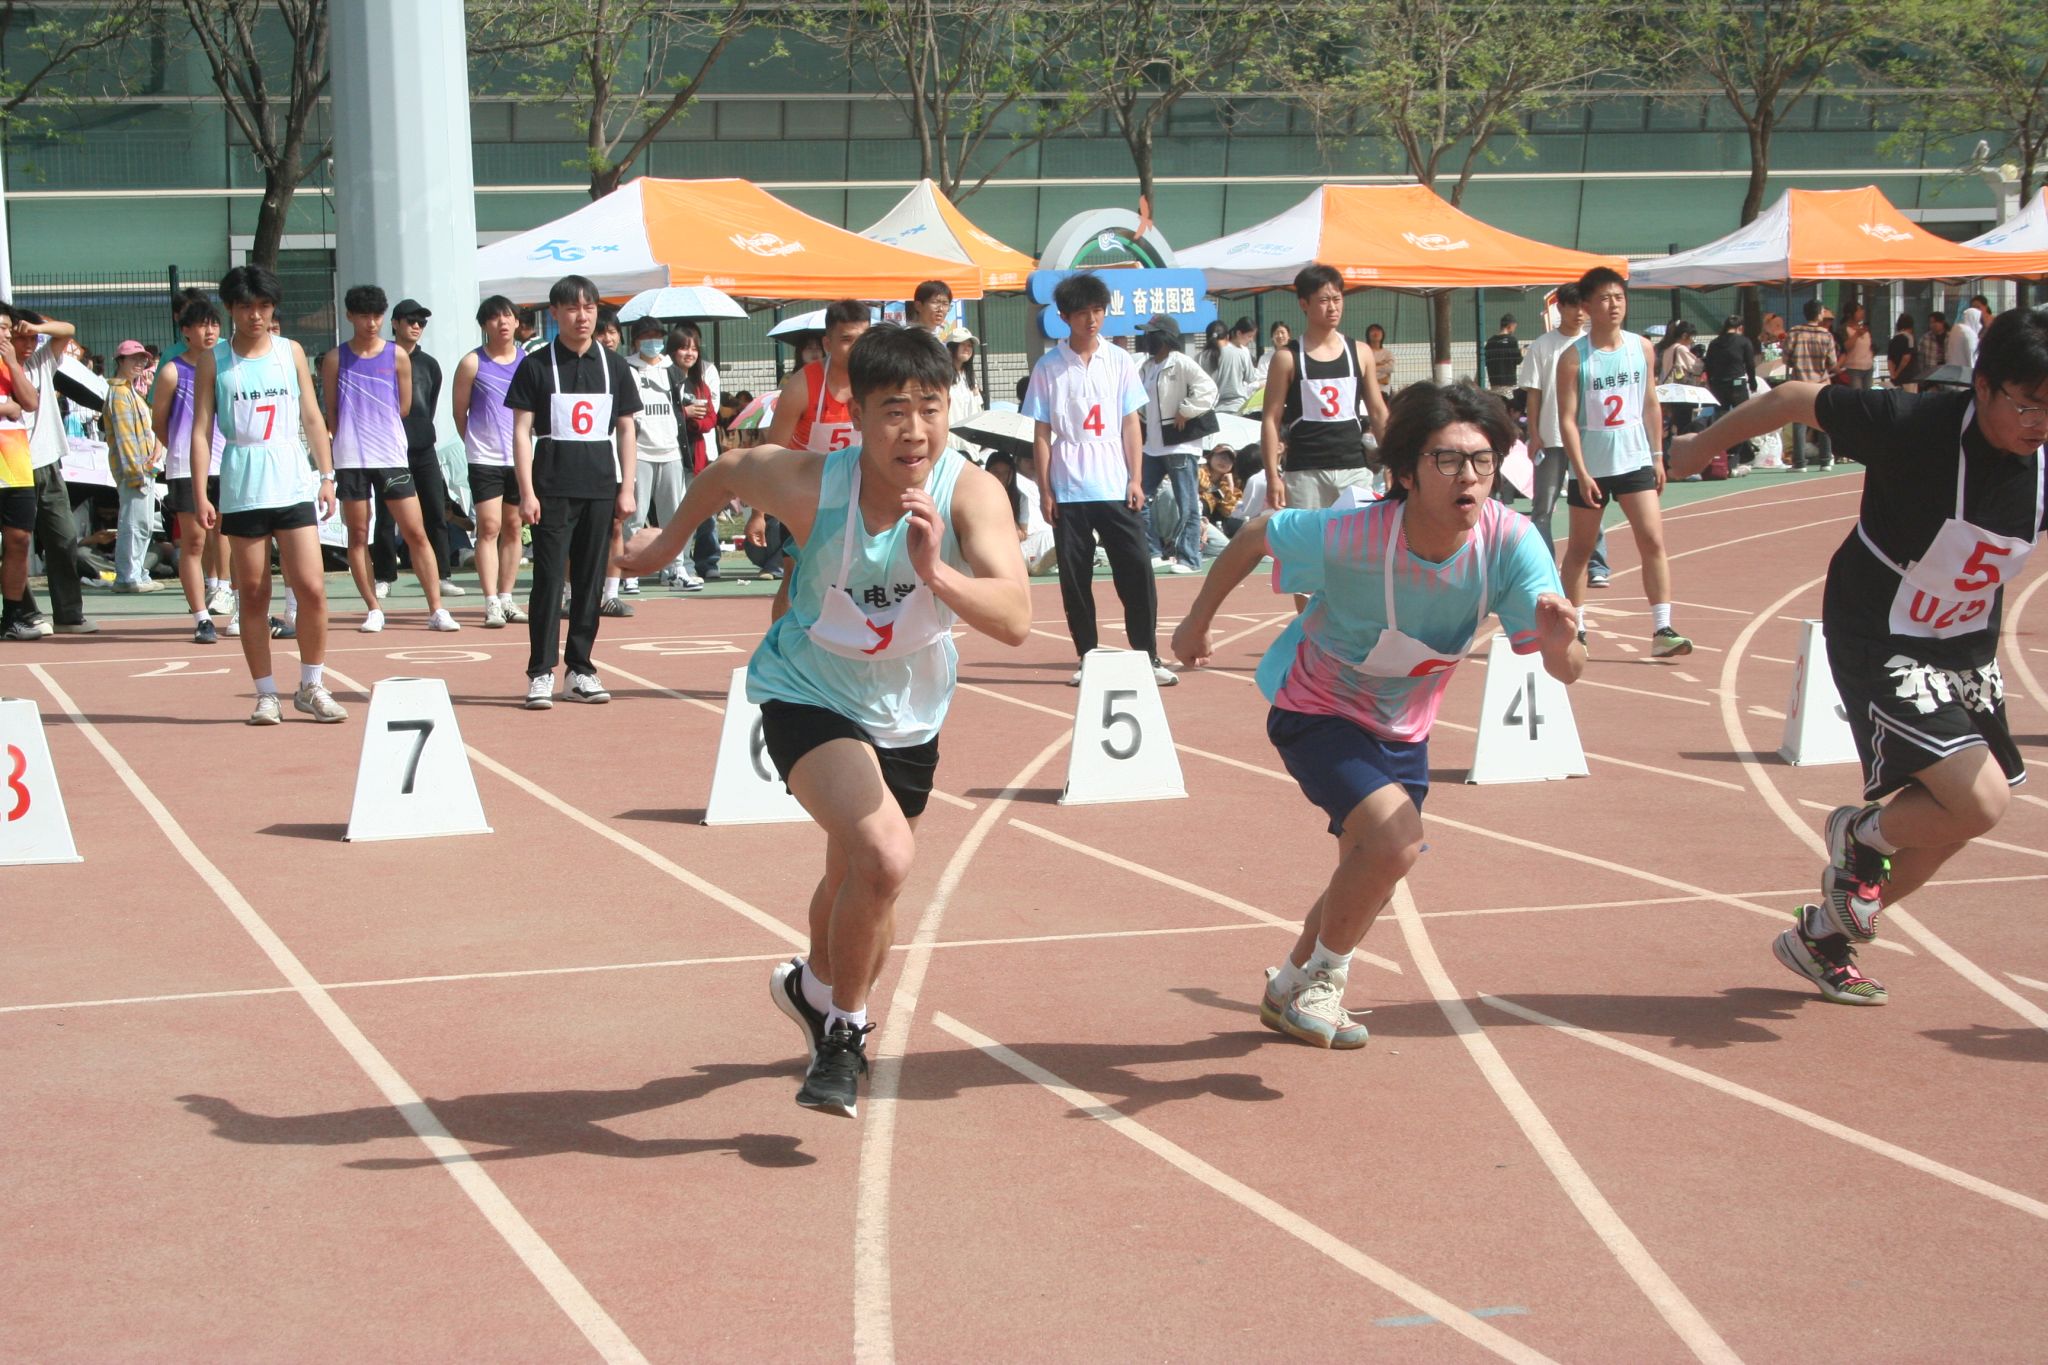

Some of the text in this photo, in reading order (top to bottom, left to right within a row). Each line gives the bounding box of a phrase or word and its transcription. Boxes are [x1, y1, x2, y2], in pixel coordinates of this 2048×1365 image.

[1132, 287, 1196, 315] 奋进图强
[571, 400, 594, 435] 6
[644, 403, 671, 416] UMA
[1319, 386, 1341, 418] 3
[1604, 394, 1626, 427] 2
[255, 404, 276, 440] 7
[1082, 404, 1106, 437] 4
[828, 428, 852, 451] 5
[1953, 540, 2012, 592] 5
[1503, 672, 1545, 740] 4
[1101, 690, 1142, 760] 5
[387, 719, 435, 794] 7
